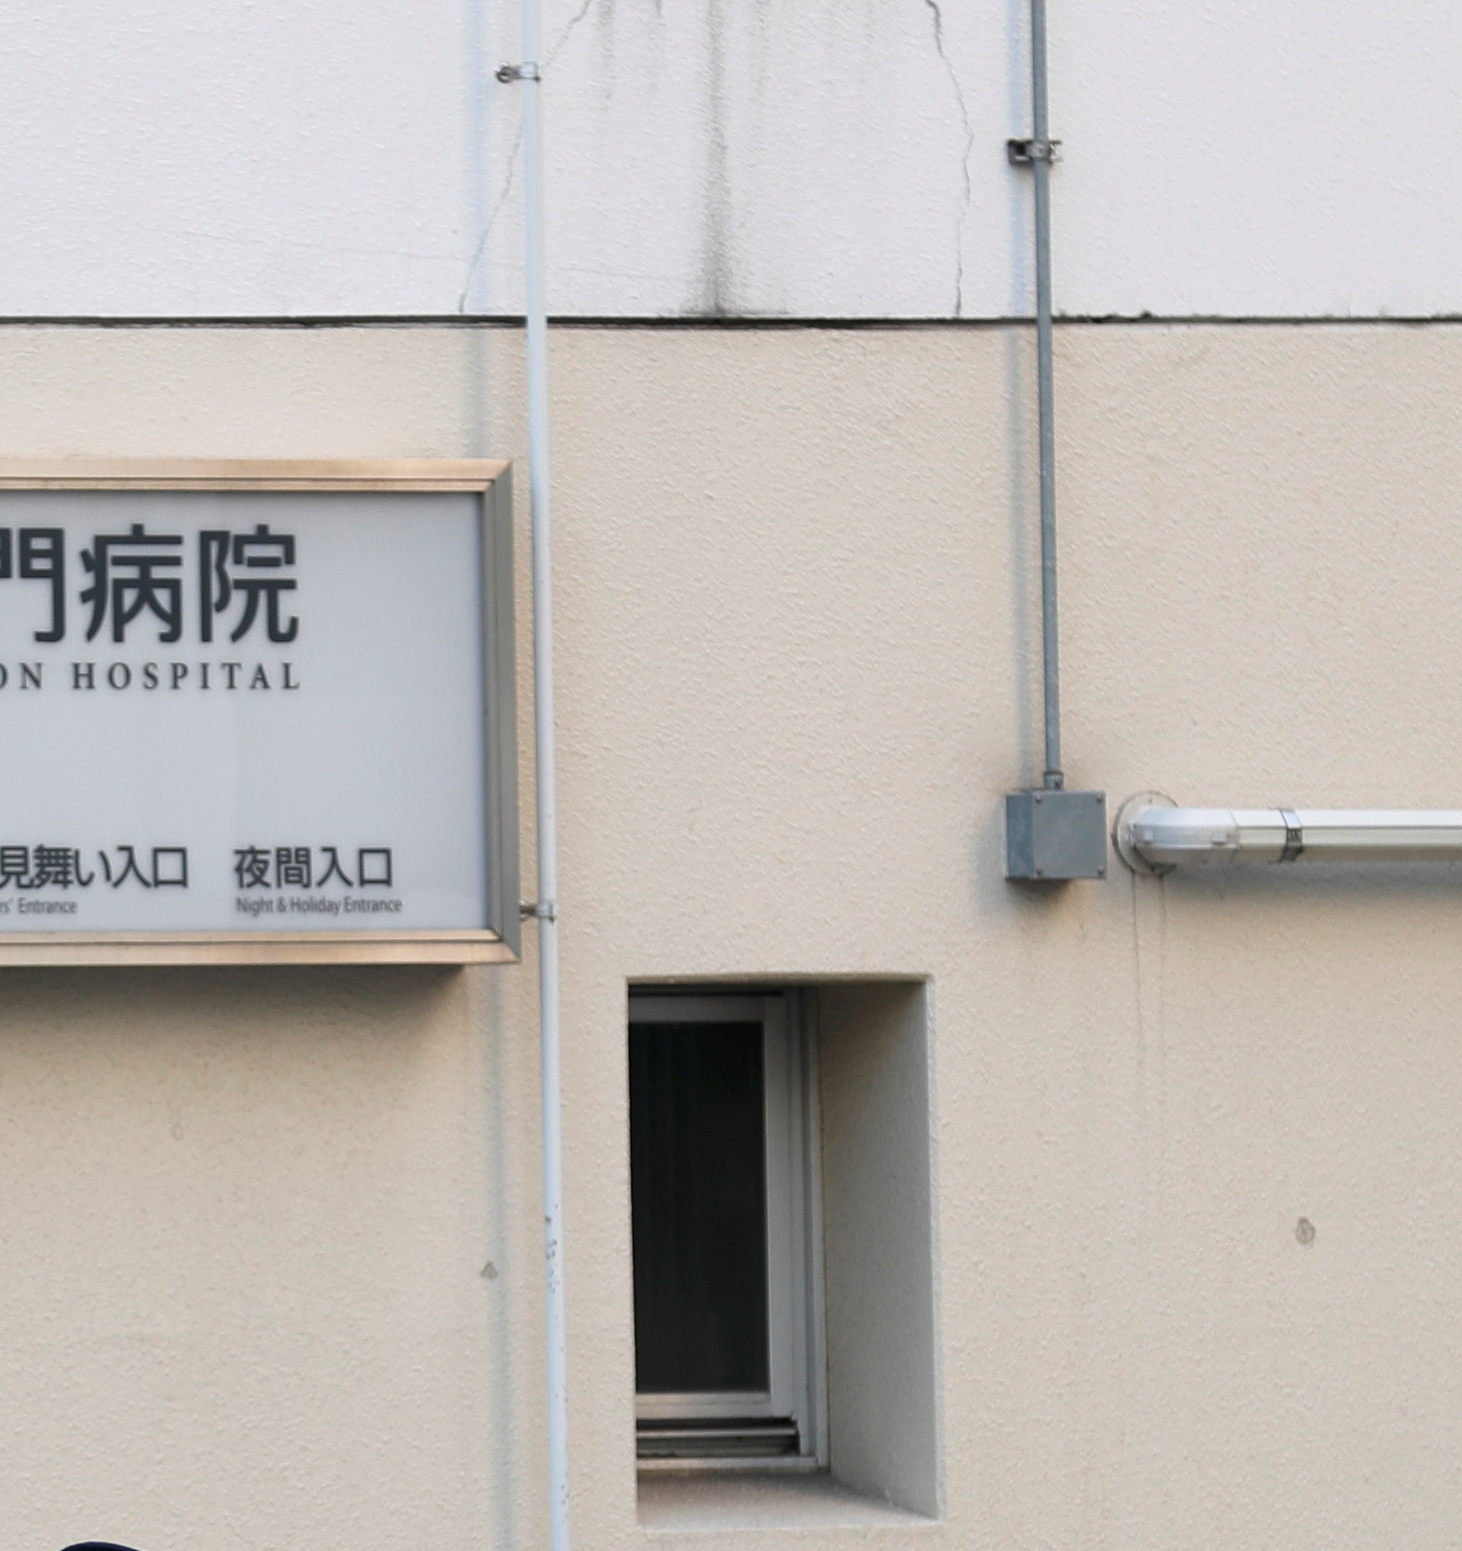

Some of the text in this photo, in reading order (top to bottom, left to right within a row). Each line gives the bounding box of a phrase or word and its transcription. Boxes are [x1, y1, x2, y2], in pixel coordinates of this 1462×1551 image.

[72, 661, 300, 691] HOSPITAL
[233, 845, 393, 889] 夜間入口
[18, 898, 78, 914] Entrance
[237, 897, 402, 917] Night & Holiday Entrance
